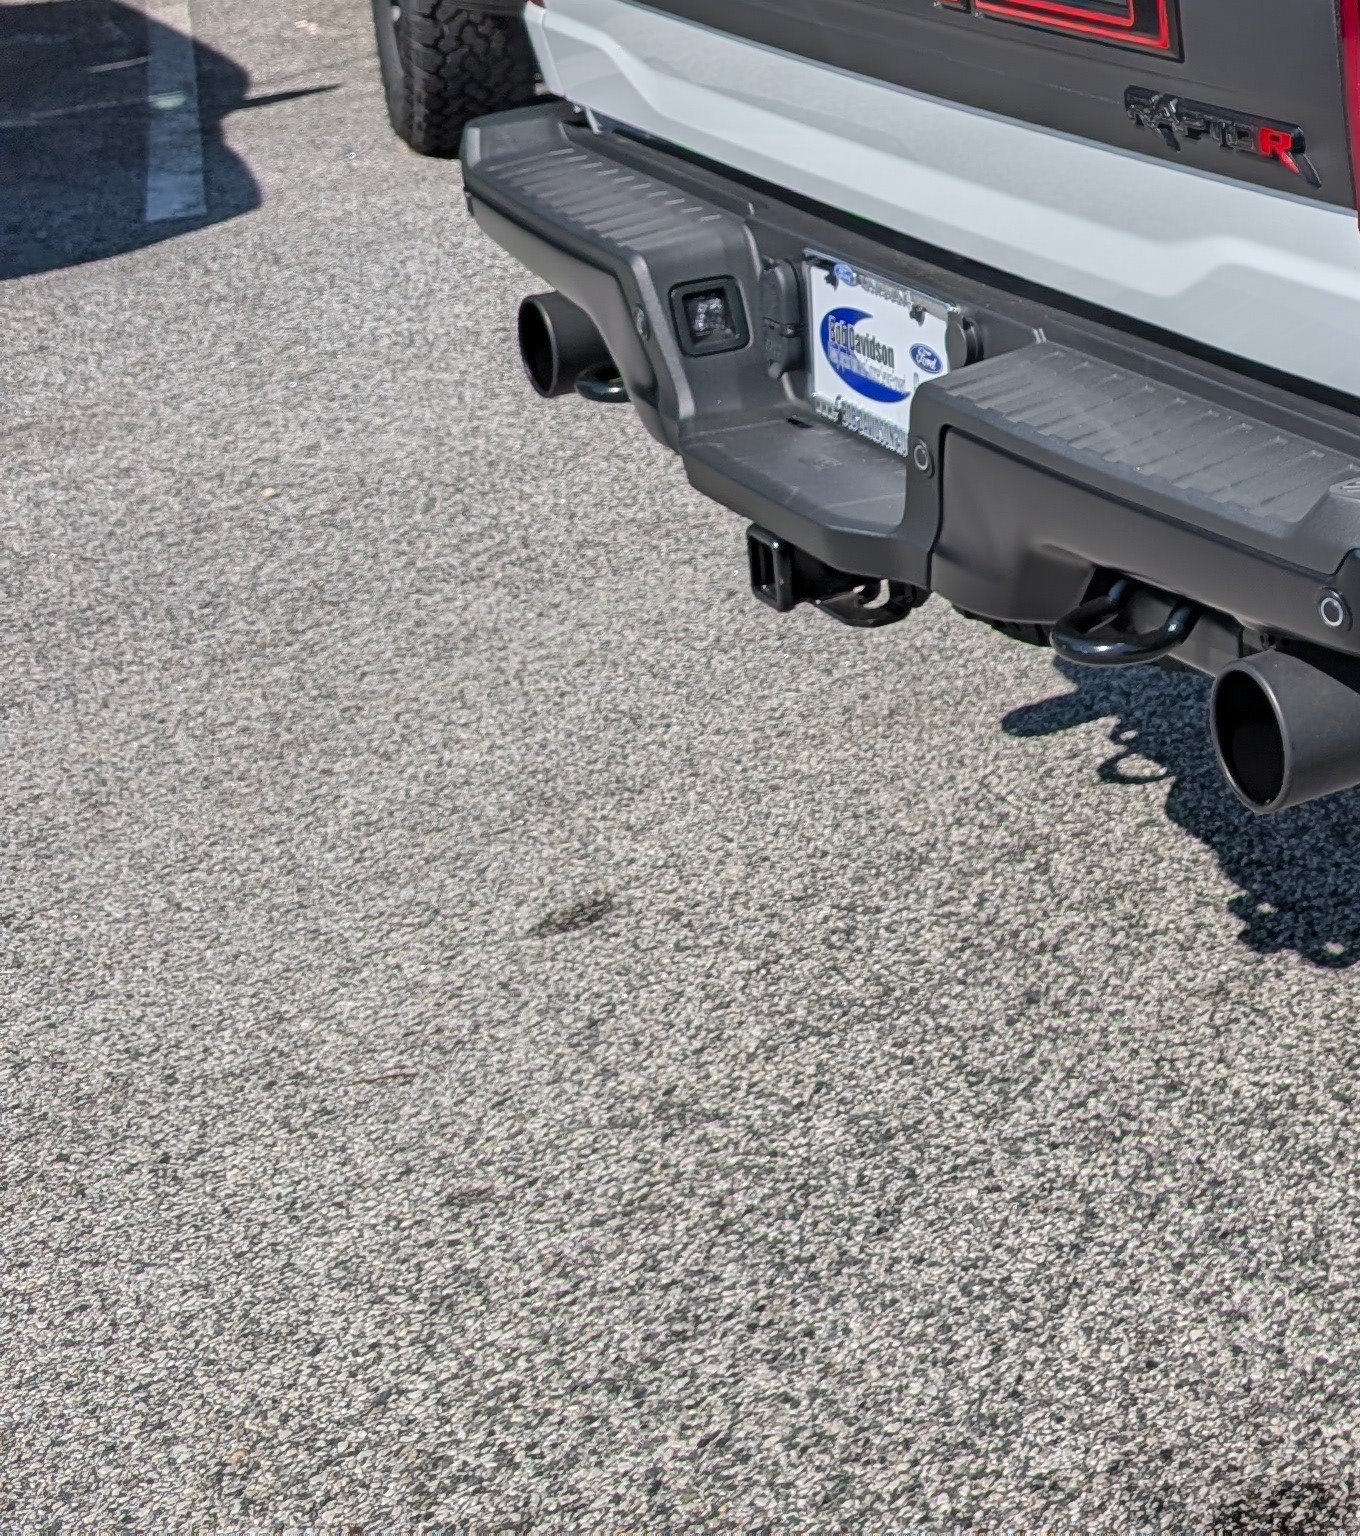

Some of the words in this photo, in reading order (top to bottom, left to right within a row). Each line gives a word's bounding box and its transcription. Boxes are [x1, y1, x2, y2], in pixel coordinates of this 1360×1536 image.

[1124, 84, 1322, 188] RAPTOR
[848, 323, 895, 369] Davidson
[914, 345, 939, 372] Ford
